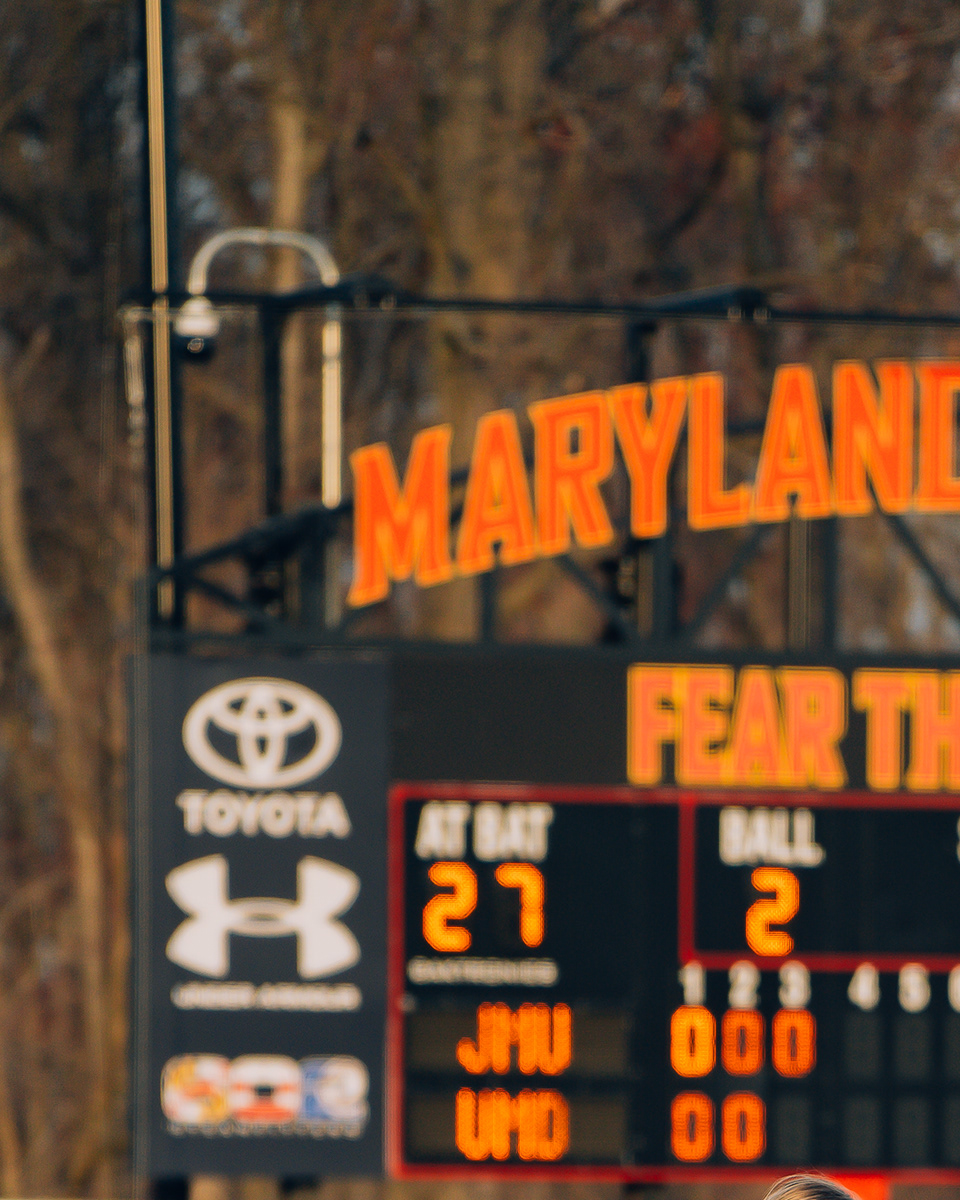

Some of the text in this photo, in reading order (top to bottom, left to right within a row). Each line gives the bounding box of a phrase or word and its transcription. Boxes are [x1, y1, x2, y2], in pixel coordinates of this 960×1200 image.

[626, 663, 848, 788] FEAR
[175, 789, 352, 838] TOYOTA
[414, 801, 554, 863] AT BAT
[718, 805, 825, 868] BALL
[422, 861, 545, 952] 27
[745, 867, 800, 957] 2
[679, 960, 706, 1007] 1
[728, 959, 761, 1009] 2
[778, 960, 811, 1009] 3
[847, 962, 880, 1011] 4
[898, 962, 931, 1013] 5
[456, 1002, 572, 1076] JMU
[455, 1087, 570, 1161] UMD
